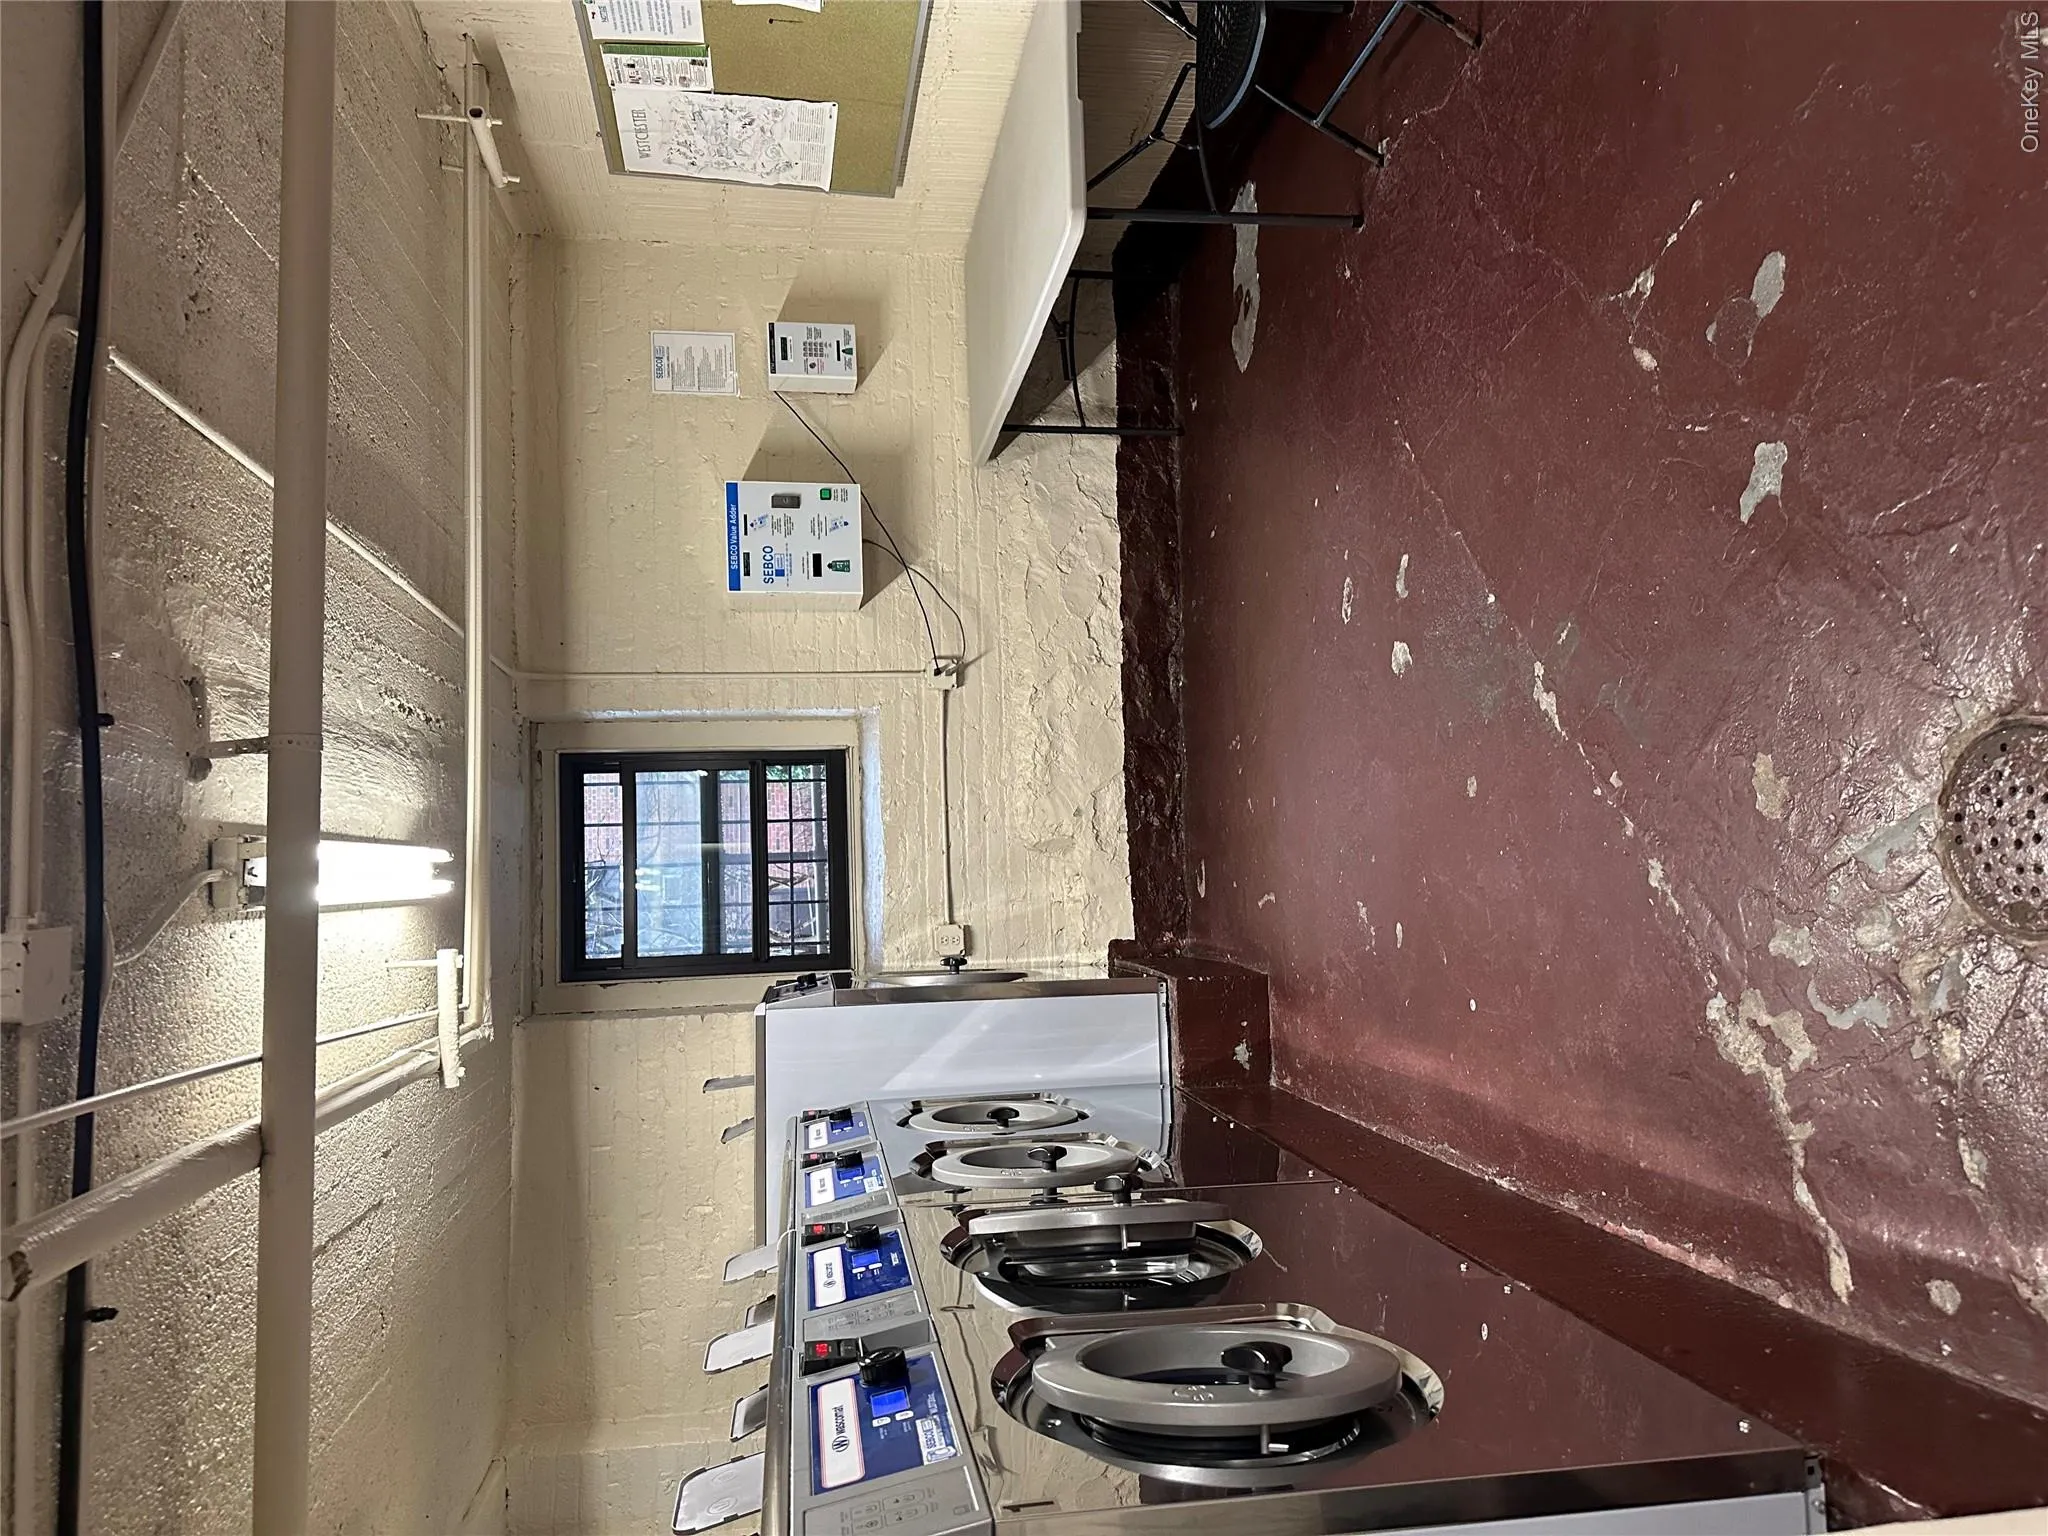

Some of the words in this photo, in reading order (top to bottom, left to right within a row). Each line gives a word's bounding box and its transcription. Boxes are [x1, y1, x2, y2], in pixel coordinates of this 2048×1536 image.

[655, 358, 664, 379] SEBCO
[729, 503, 737, 524] Adder
[729, 525, 737, 544] Value
[730, 545, 738, 570] SEBCO
[762, 545, 774, 584] SEBCO
[832, 1406, 846, 1435] wascomat
